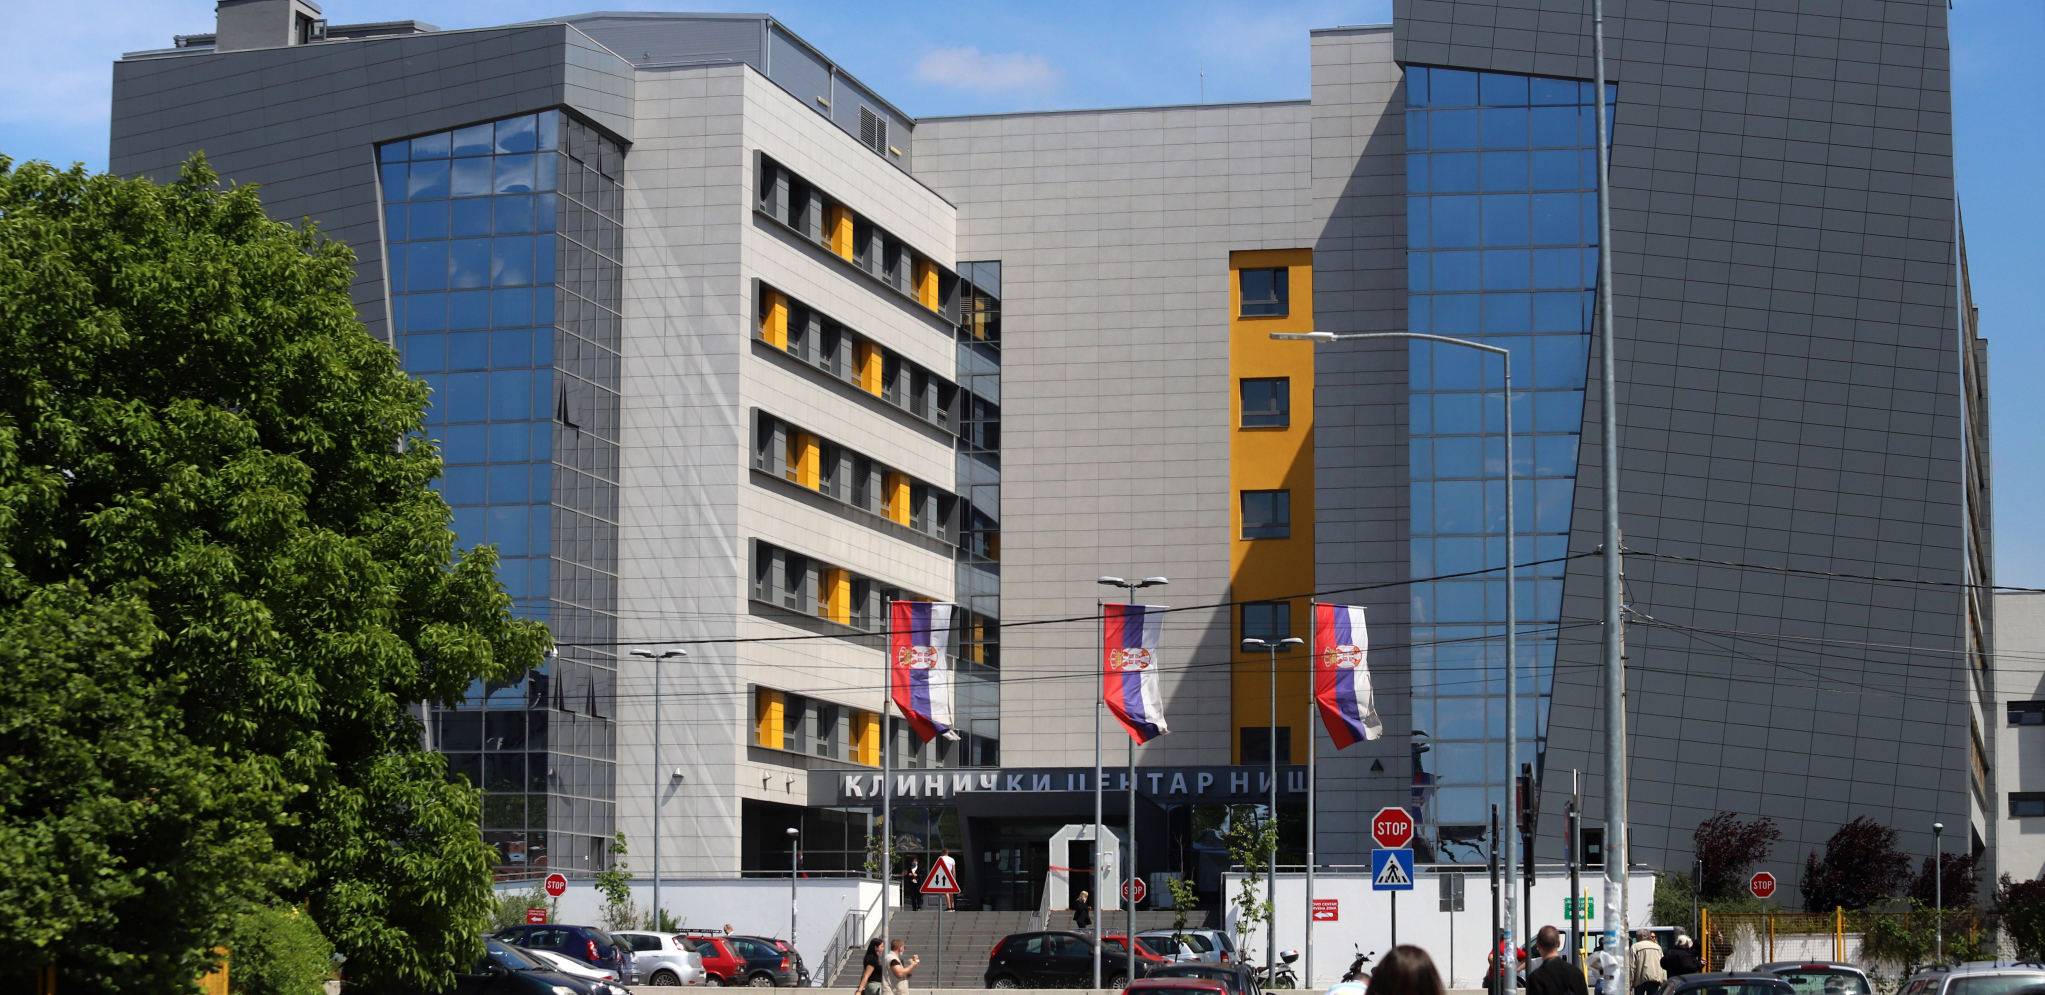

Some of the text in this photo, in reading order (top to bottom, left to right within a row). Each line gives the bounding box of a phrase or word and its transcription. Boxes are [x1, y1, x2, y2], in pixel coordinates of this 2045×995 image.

[845, 773, 1050, 797] КЛИНИЧКИ
[1377, 821, 1408, 836] STOP
[547, 880, 565, 890] STOP
[1753, 880, 1773, 890] STOP
[1124, 886, 1143, 895] SOP
